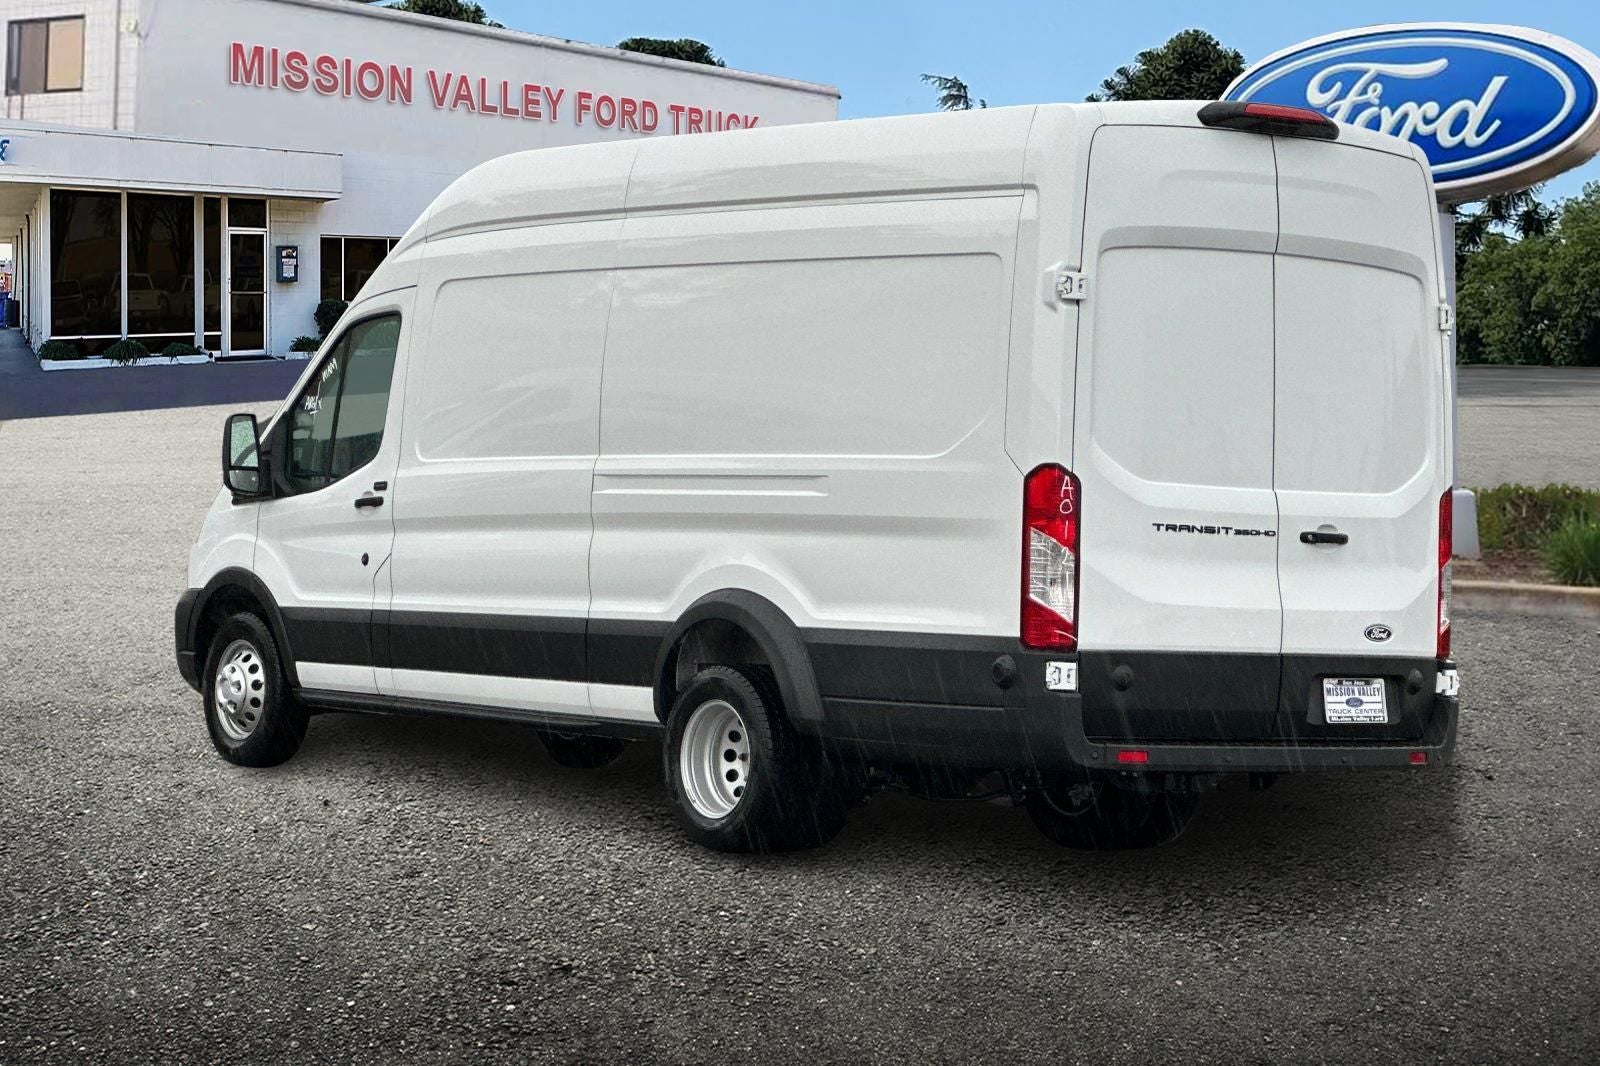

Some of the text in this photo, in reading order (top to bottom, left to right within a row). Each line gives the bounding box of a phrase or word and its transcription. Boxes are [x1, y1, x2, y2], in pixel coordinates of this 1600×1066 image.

[230, 41, 414, 104] MISSION
[427, 68, 565, 122] VALLEY
[576, 90, 660, 134] FORD
[1306, 57, 1508, 148] Ford
[1152, 523, 1233, 535] TRANSIT
[1370, 627, 1389, 639] Ford
[1326, 686, 1381, 697] MISSION VALLEY
